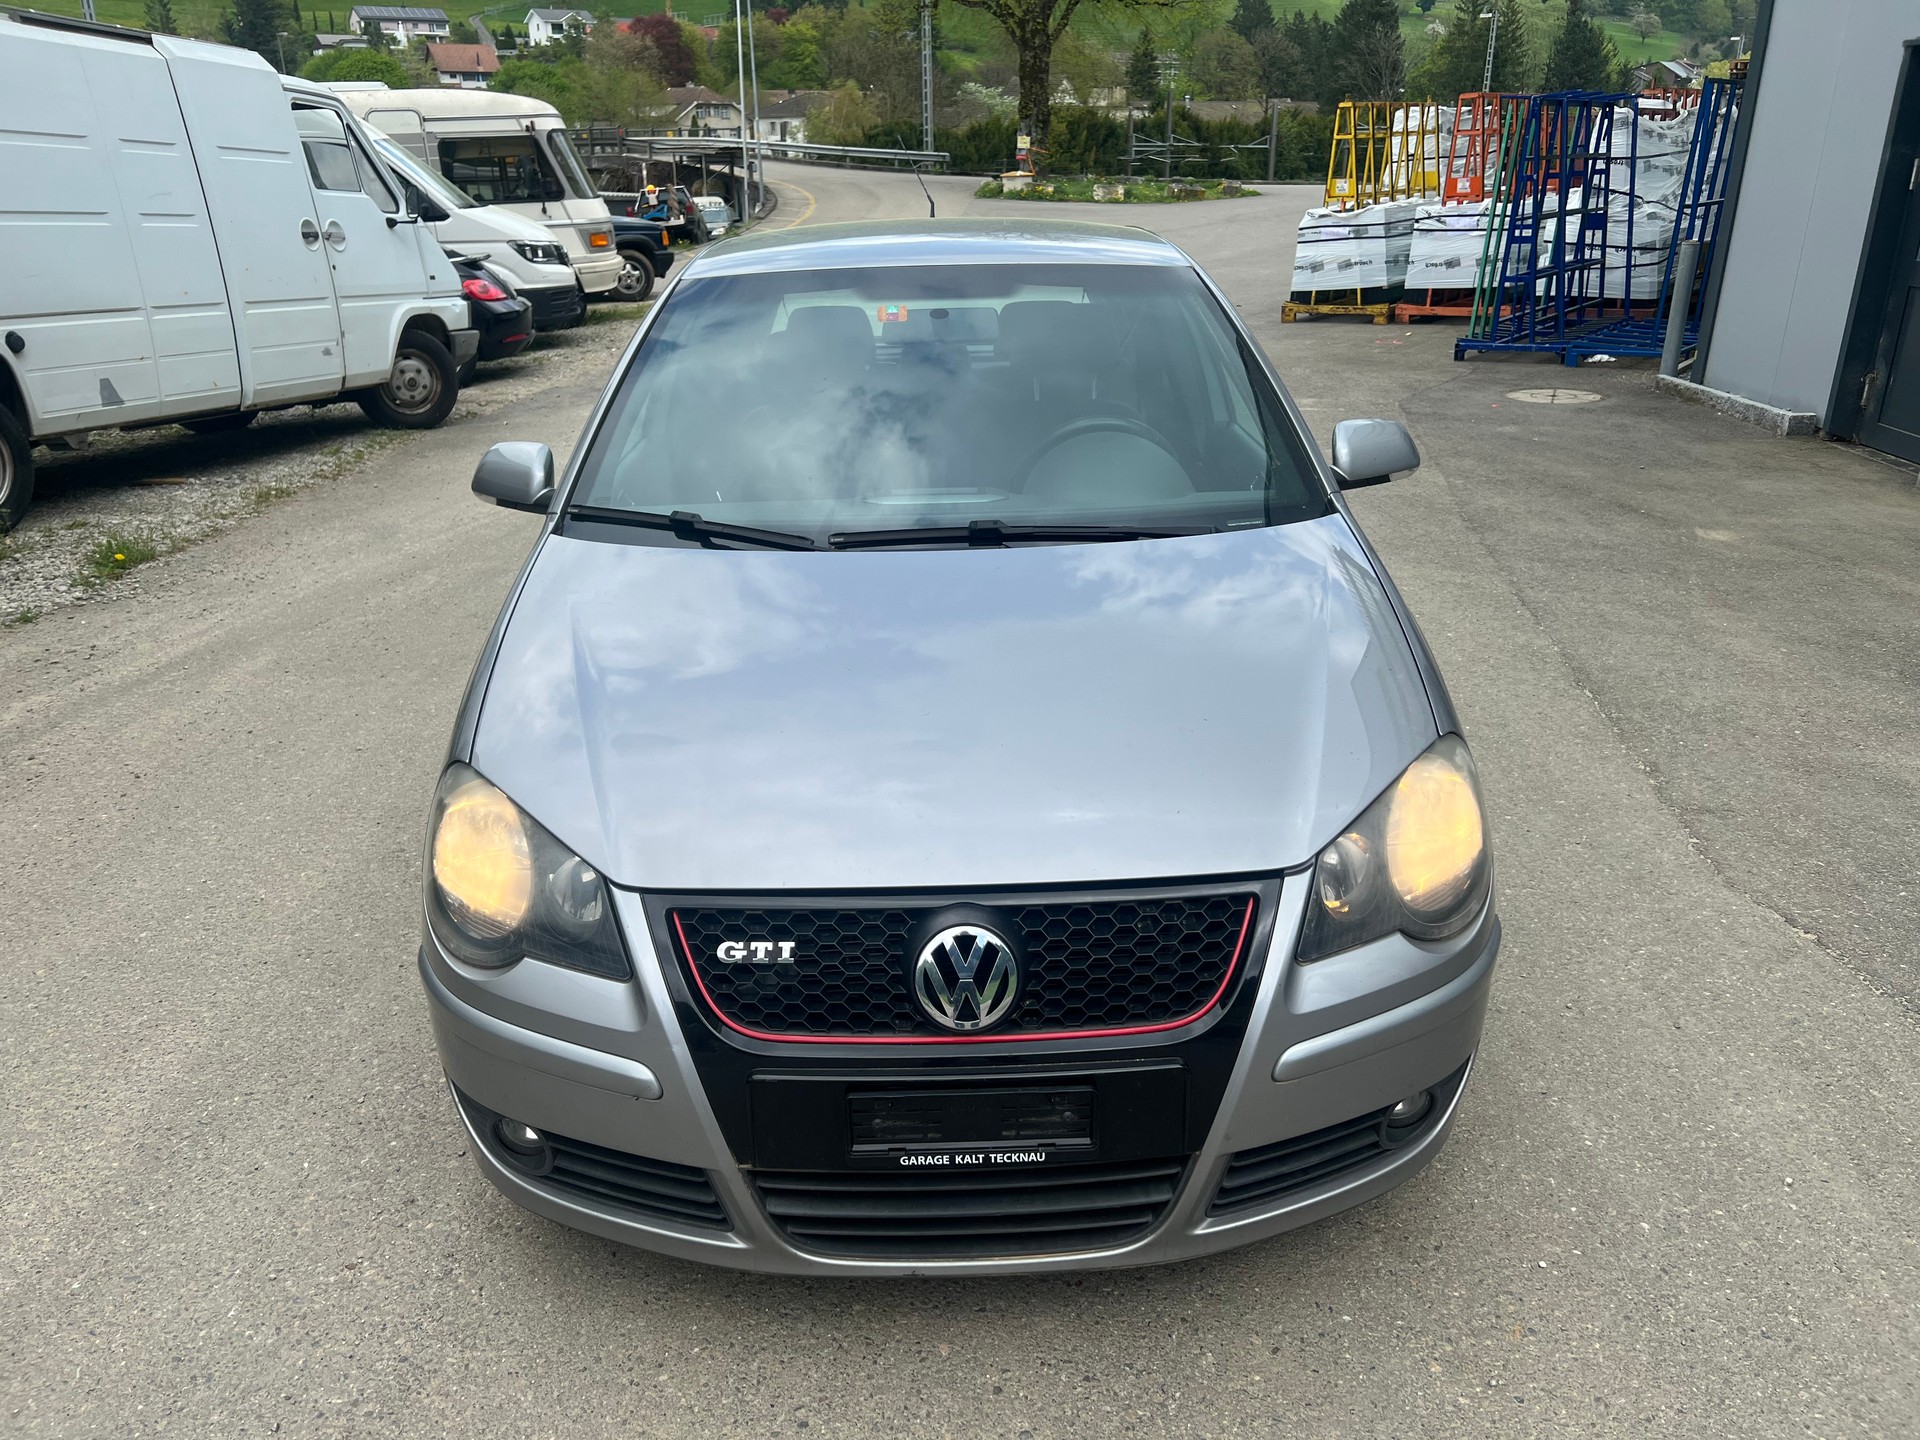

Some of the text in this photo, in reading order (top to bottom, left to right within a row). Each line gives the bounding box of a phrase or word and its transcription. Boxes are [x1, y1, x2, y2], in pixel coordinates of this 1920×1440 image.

[716, 941, 796, 964] GTI
[900, 1152, 1046, 1166] GARAGE KALT TECKNAU
